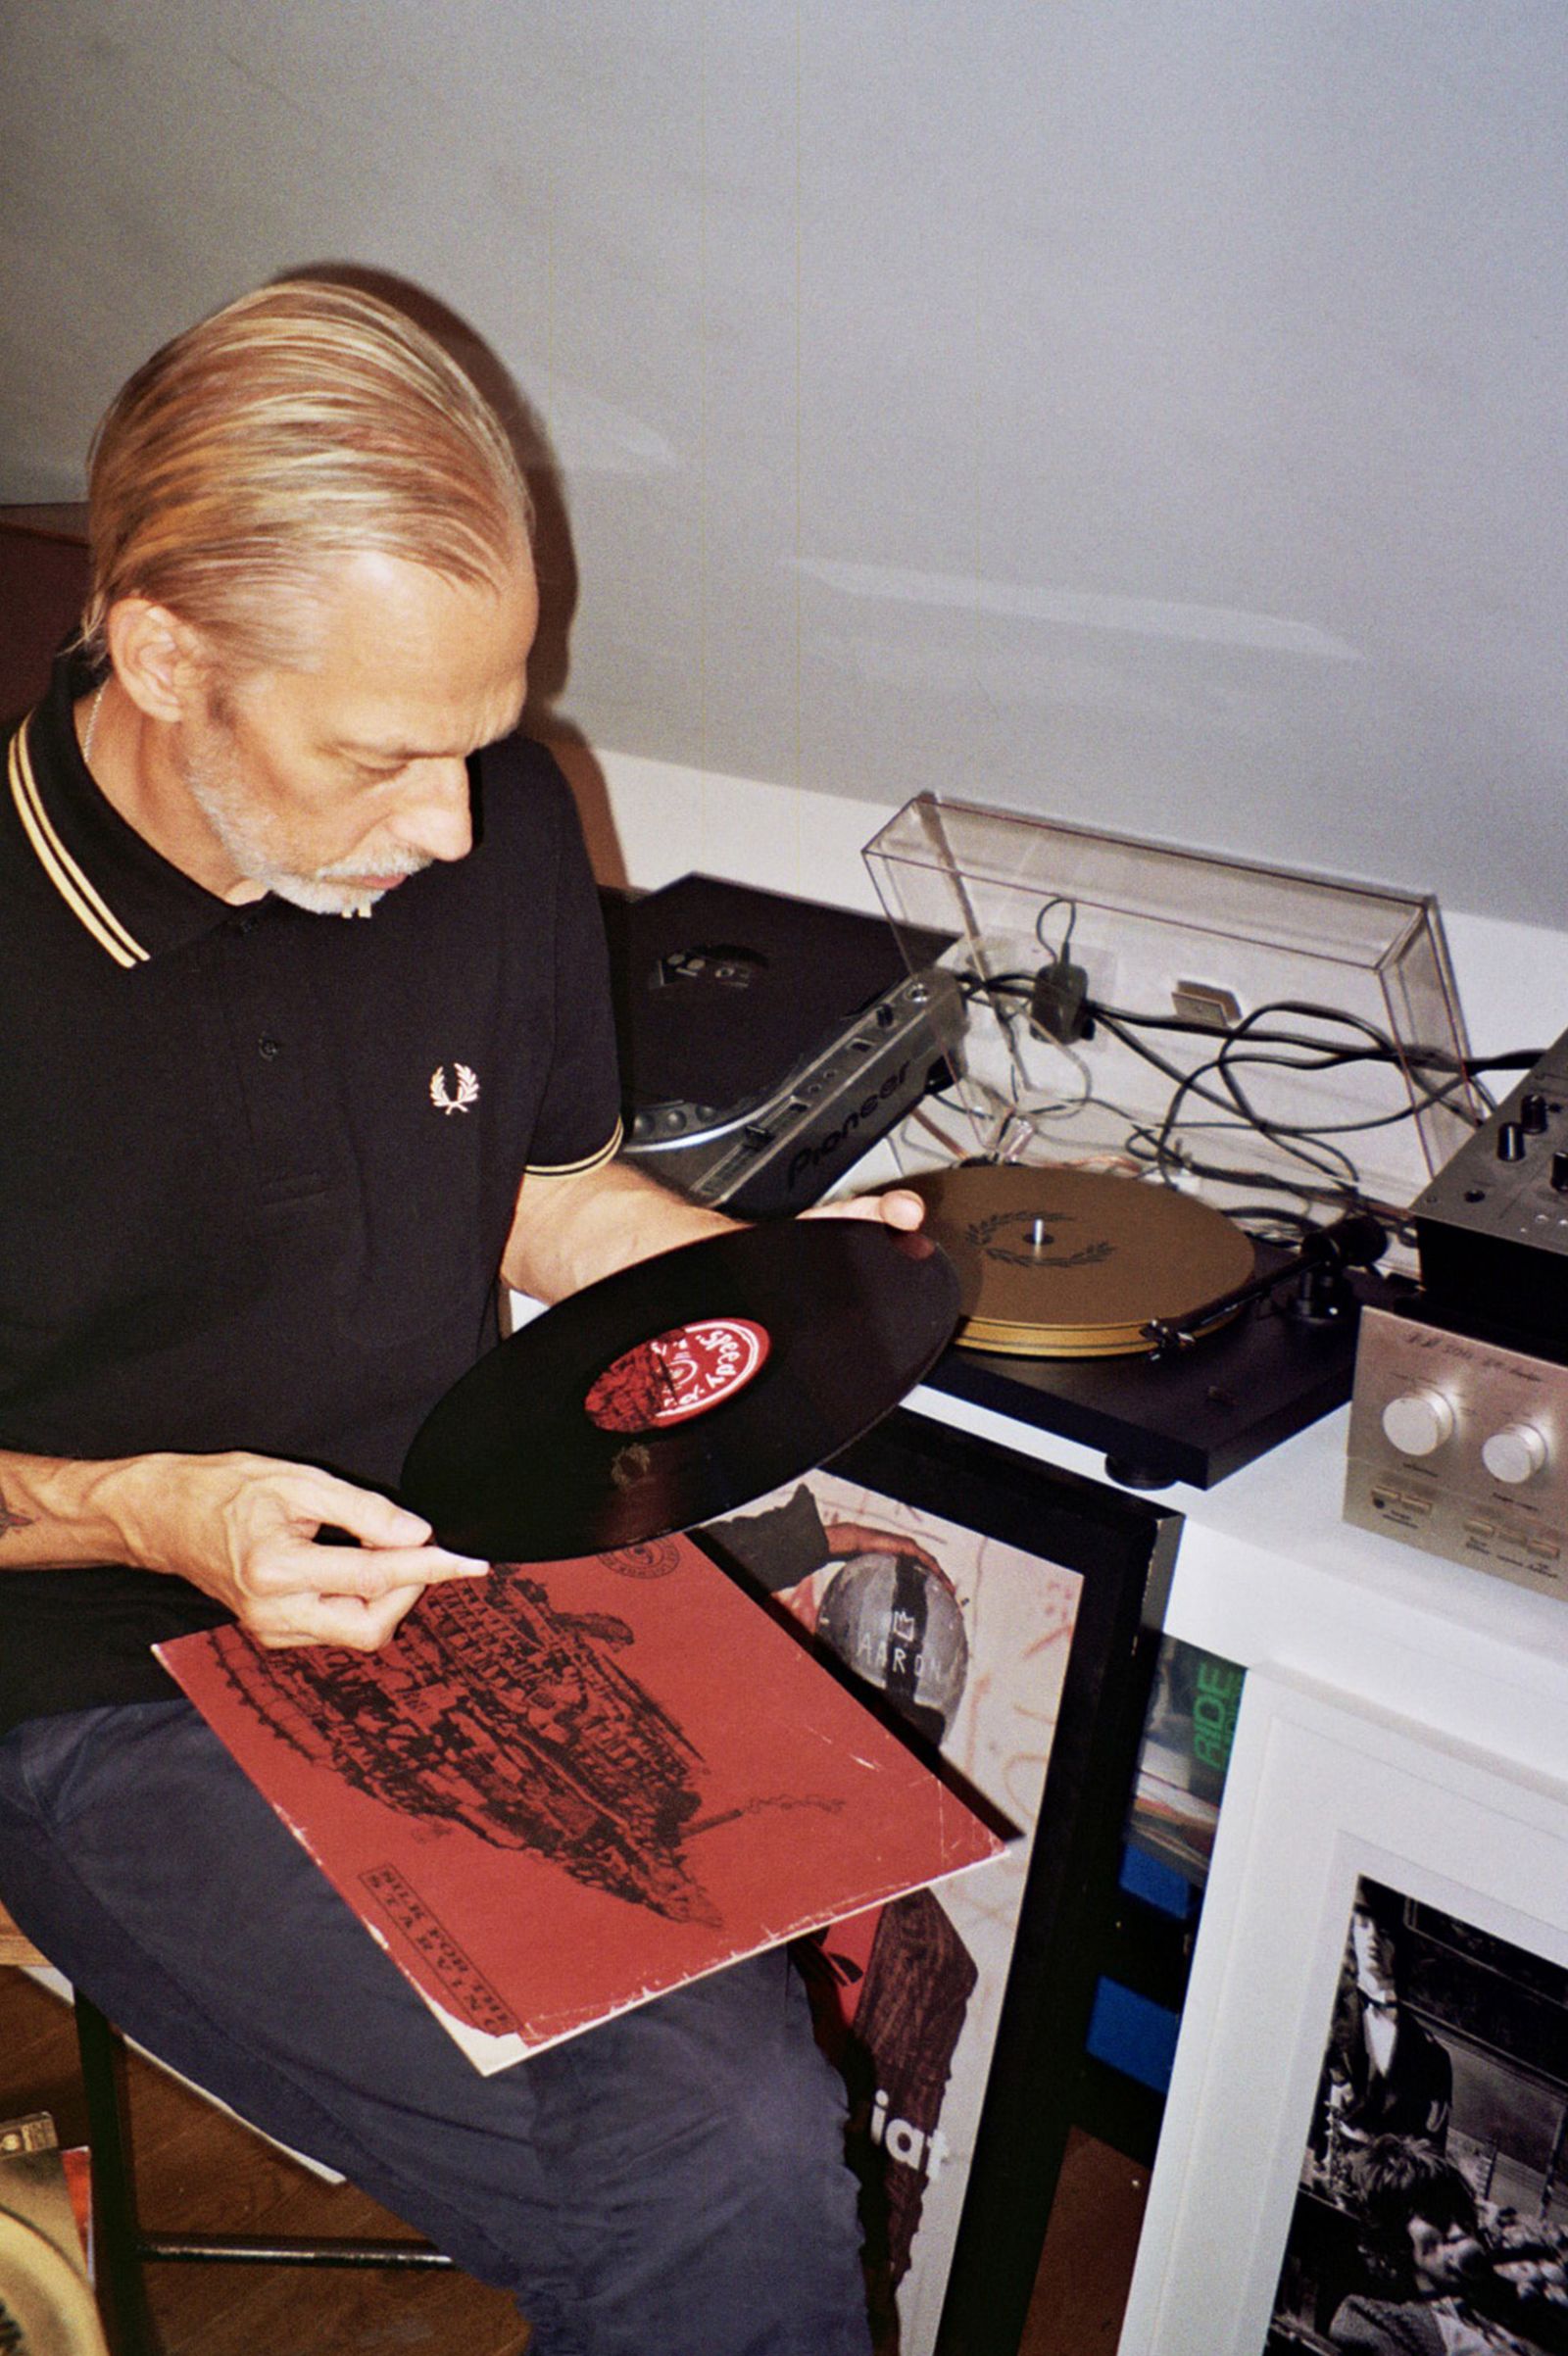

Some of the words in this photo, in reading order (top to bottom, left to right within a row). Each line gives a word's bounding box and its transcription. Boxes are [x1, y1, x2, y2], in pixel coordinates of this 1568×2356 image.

[788, 1060, 910, 1190] Pioneer
[698, 1330, 741, 1389] Speedy
[1193, 1660, 1231, 1770] RIDE
